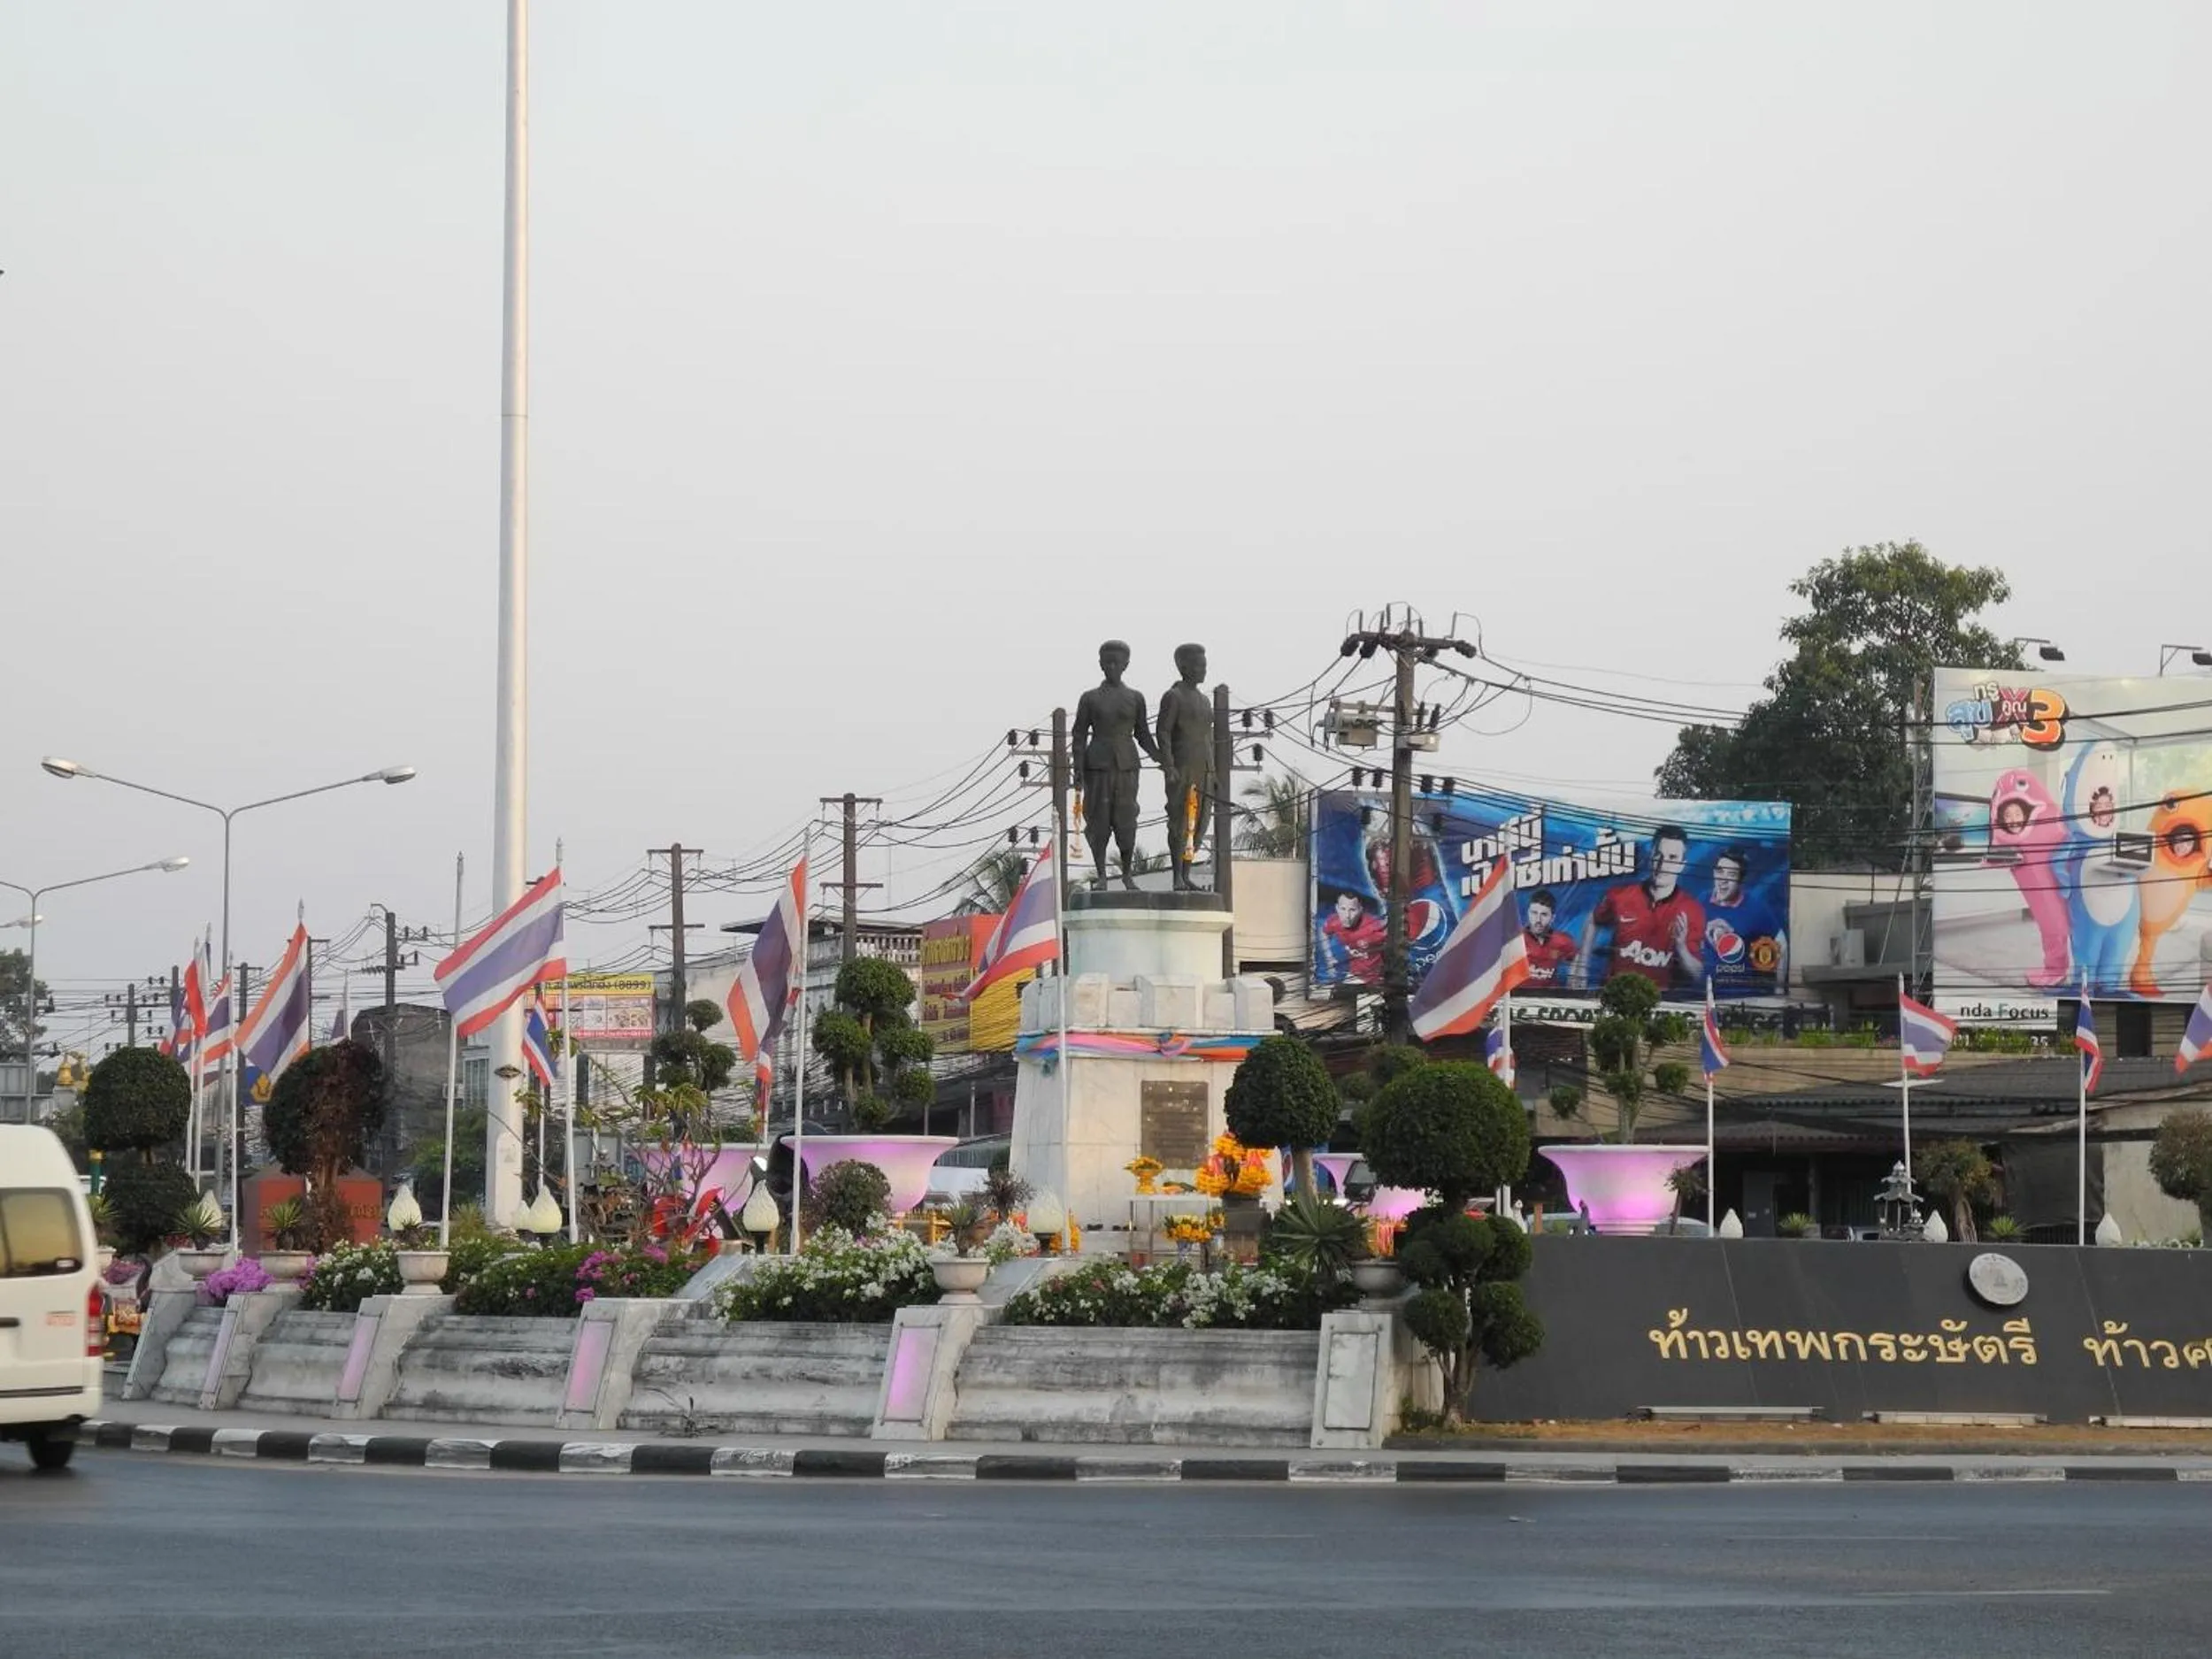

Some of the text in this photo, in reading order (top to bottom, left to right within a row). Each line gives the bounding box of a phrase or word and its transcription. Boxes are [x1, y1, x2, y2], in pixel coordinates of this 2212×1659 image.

[1649, 1309, 2037, 1365] ท้าวเทพกระษัตรี
